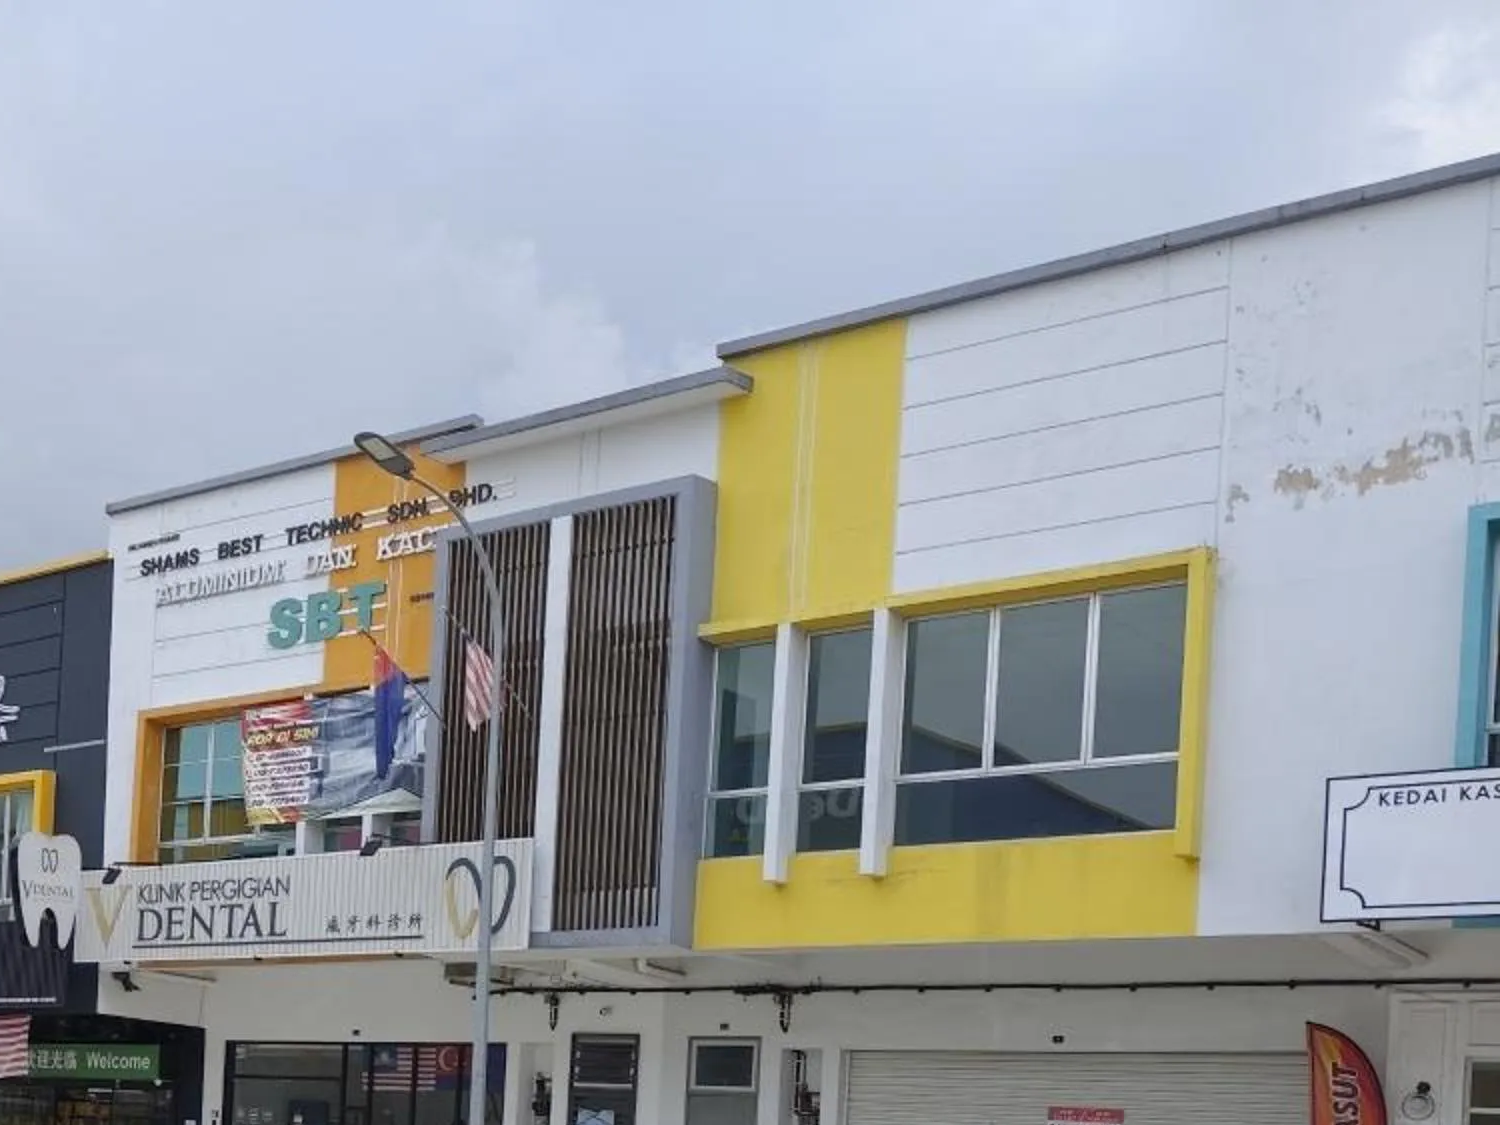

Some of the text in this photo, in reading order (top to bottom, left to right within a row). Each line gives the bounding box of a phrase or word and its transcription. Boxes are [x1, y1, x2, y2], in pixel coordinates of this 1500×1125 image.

[140, 548, 200, 577] SHAMS
[217, 534, 264, 560] BEST
[285, 511, 364, 547] TECHNIC
[267, 580, 387, 650] SBT
[1378, 787, 1447, 807] KEDAI
[189, 874, 291, 901] PERGIGIAN
[137, 901, 288, 942] DENTAL
[86, 1050, 151, 1070] Welcome
